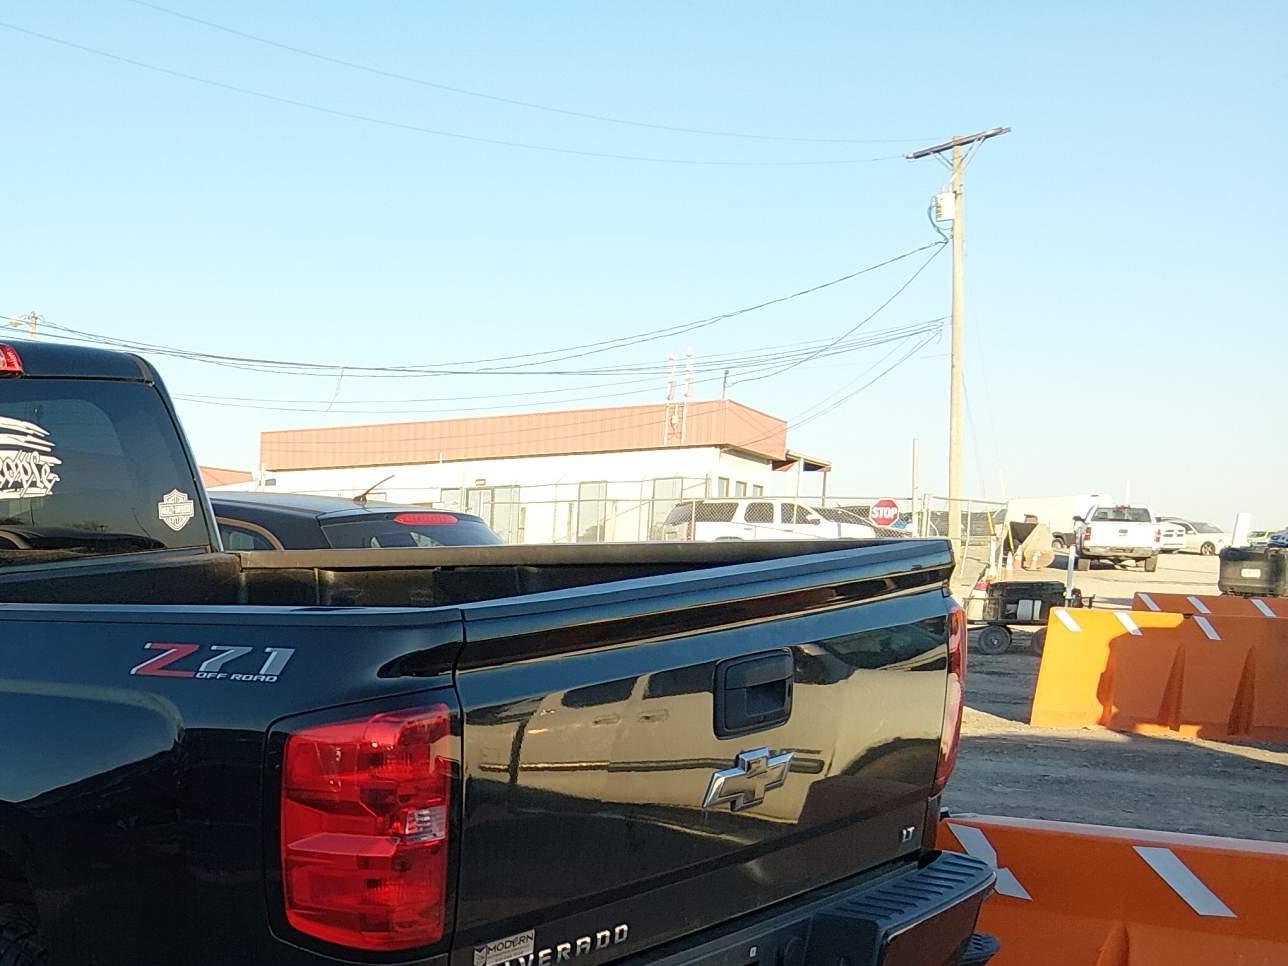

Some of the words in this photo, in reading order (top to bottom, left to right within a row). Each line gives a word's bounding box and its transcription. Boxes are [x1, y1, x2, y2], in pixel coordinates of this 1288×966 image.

[872, 506, 898, 519] STOP
[130, 642, 296, 678] Z71
[196, 671, 226, 680] OFF
[230, 673, 278, 682] ROAD
[903, 826, 915, 842] LT
[487, 932, 534, 955] MODERN
